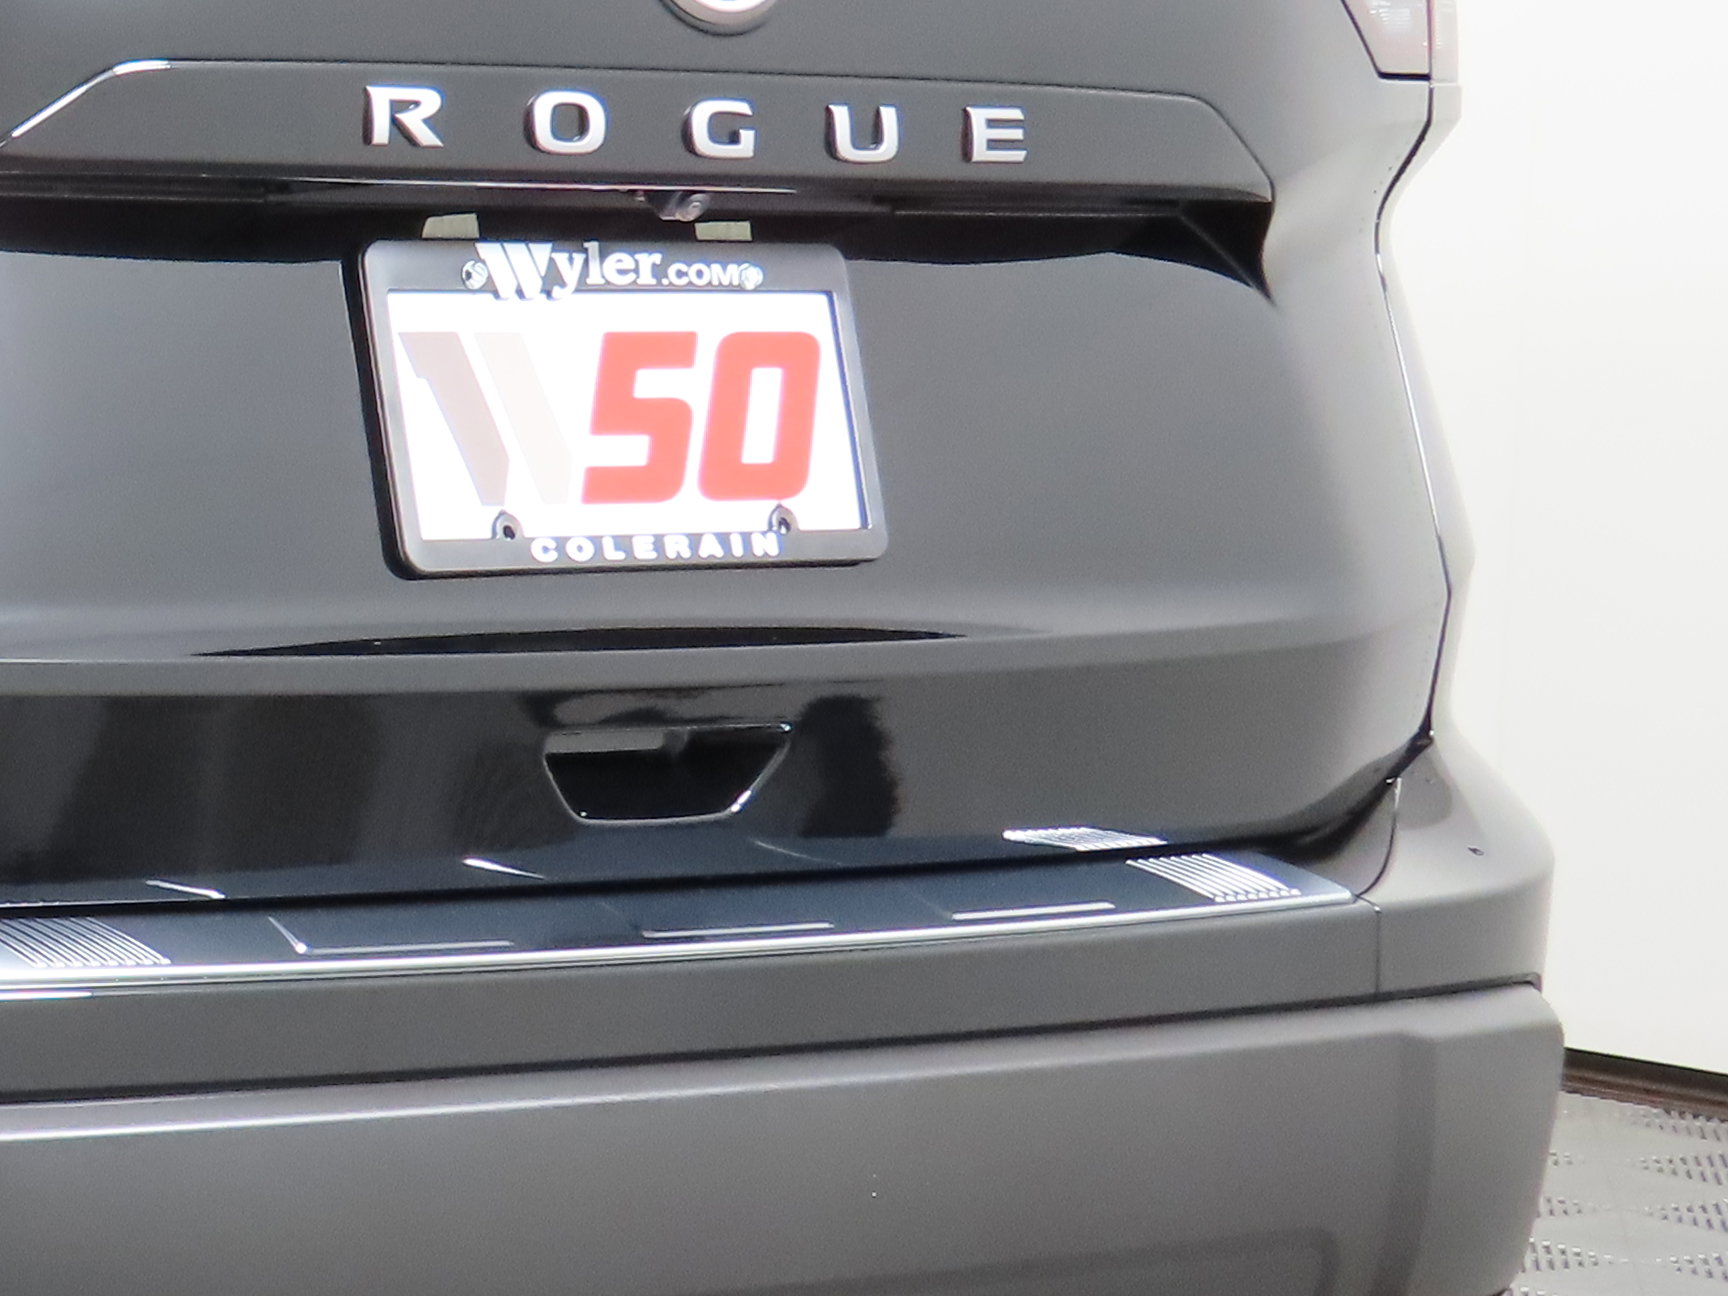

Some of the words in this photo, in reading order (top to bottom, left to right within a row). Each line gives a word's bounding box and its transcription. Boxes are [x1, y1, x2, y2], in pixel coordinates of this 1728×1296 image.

[362, 84, 1028, 164] ROGUE
[581, 331, 821, 505] 50
[530, 531, 780, 563] COLERAIN
